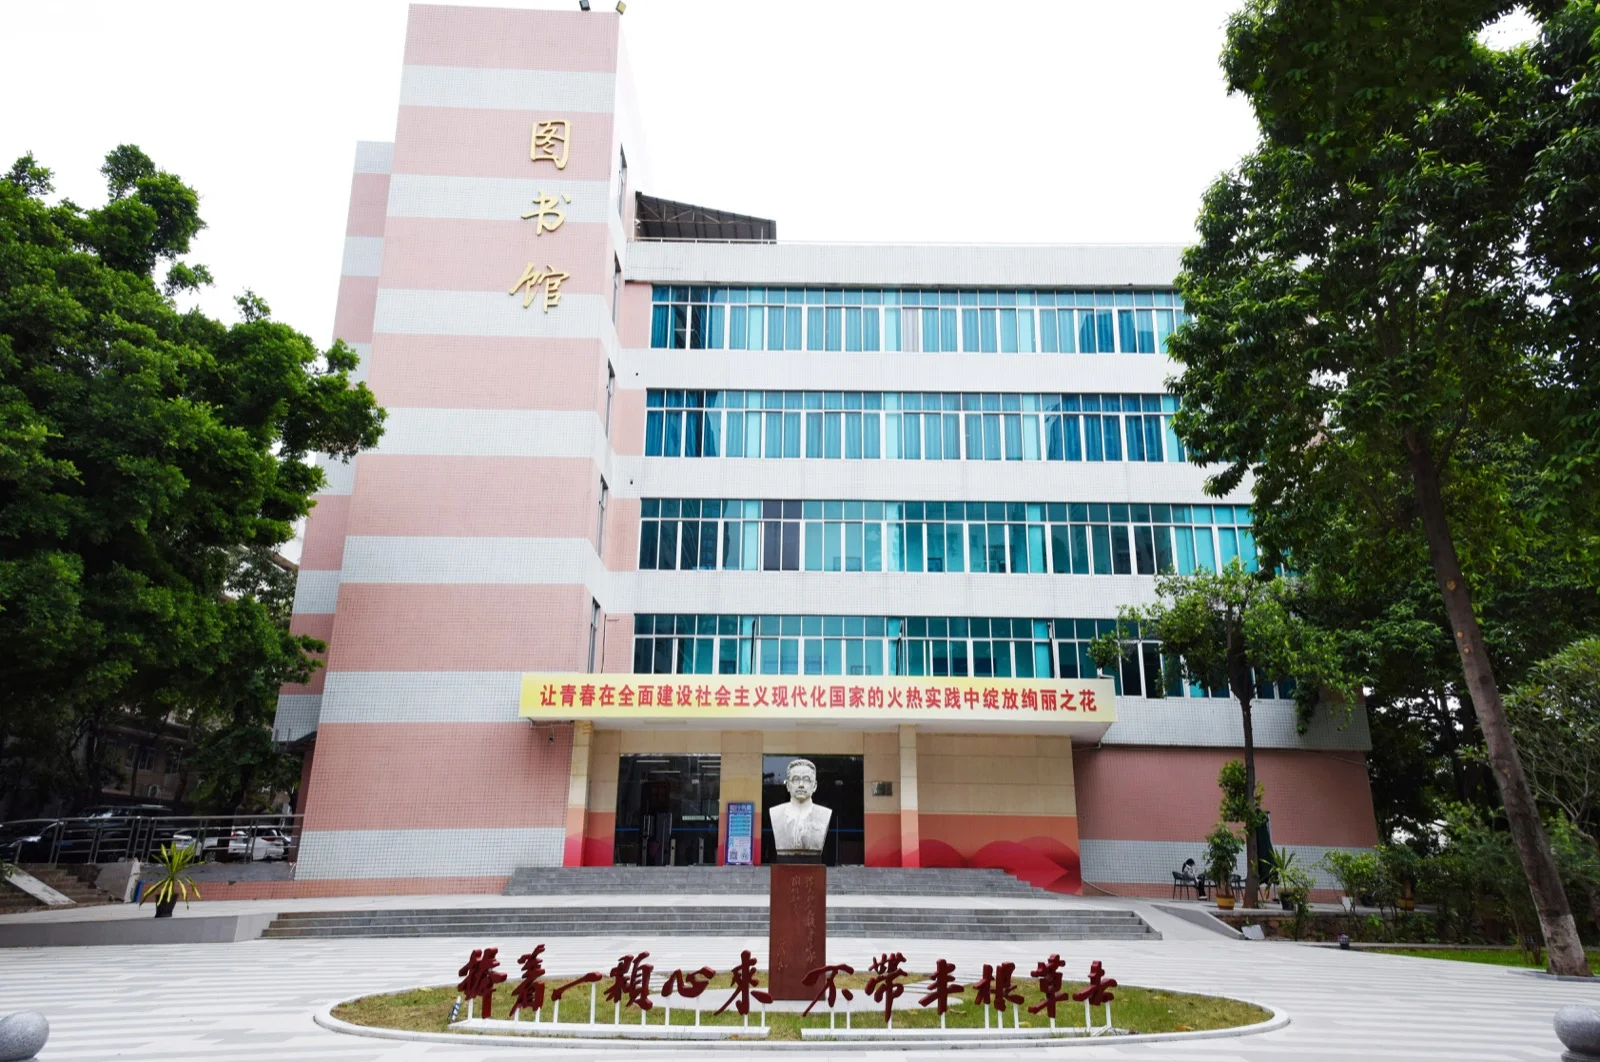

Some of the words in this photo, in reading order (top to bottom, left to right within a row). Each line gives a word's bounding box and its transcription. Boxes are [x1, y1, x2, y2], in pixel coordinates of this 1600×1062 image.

[509, 119, 571, 313] 图书馆
[540, 683, 1098, 713] 让青春在全面建设社会主义现代化国家的火热实践中绽放绚丽之花
